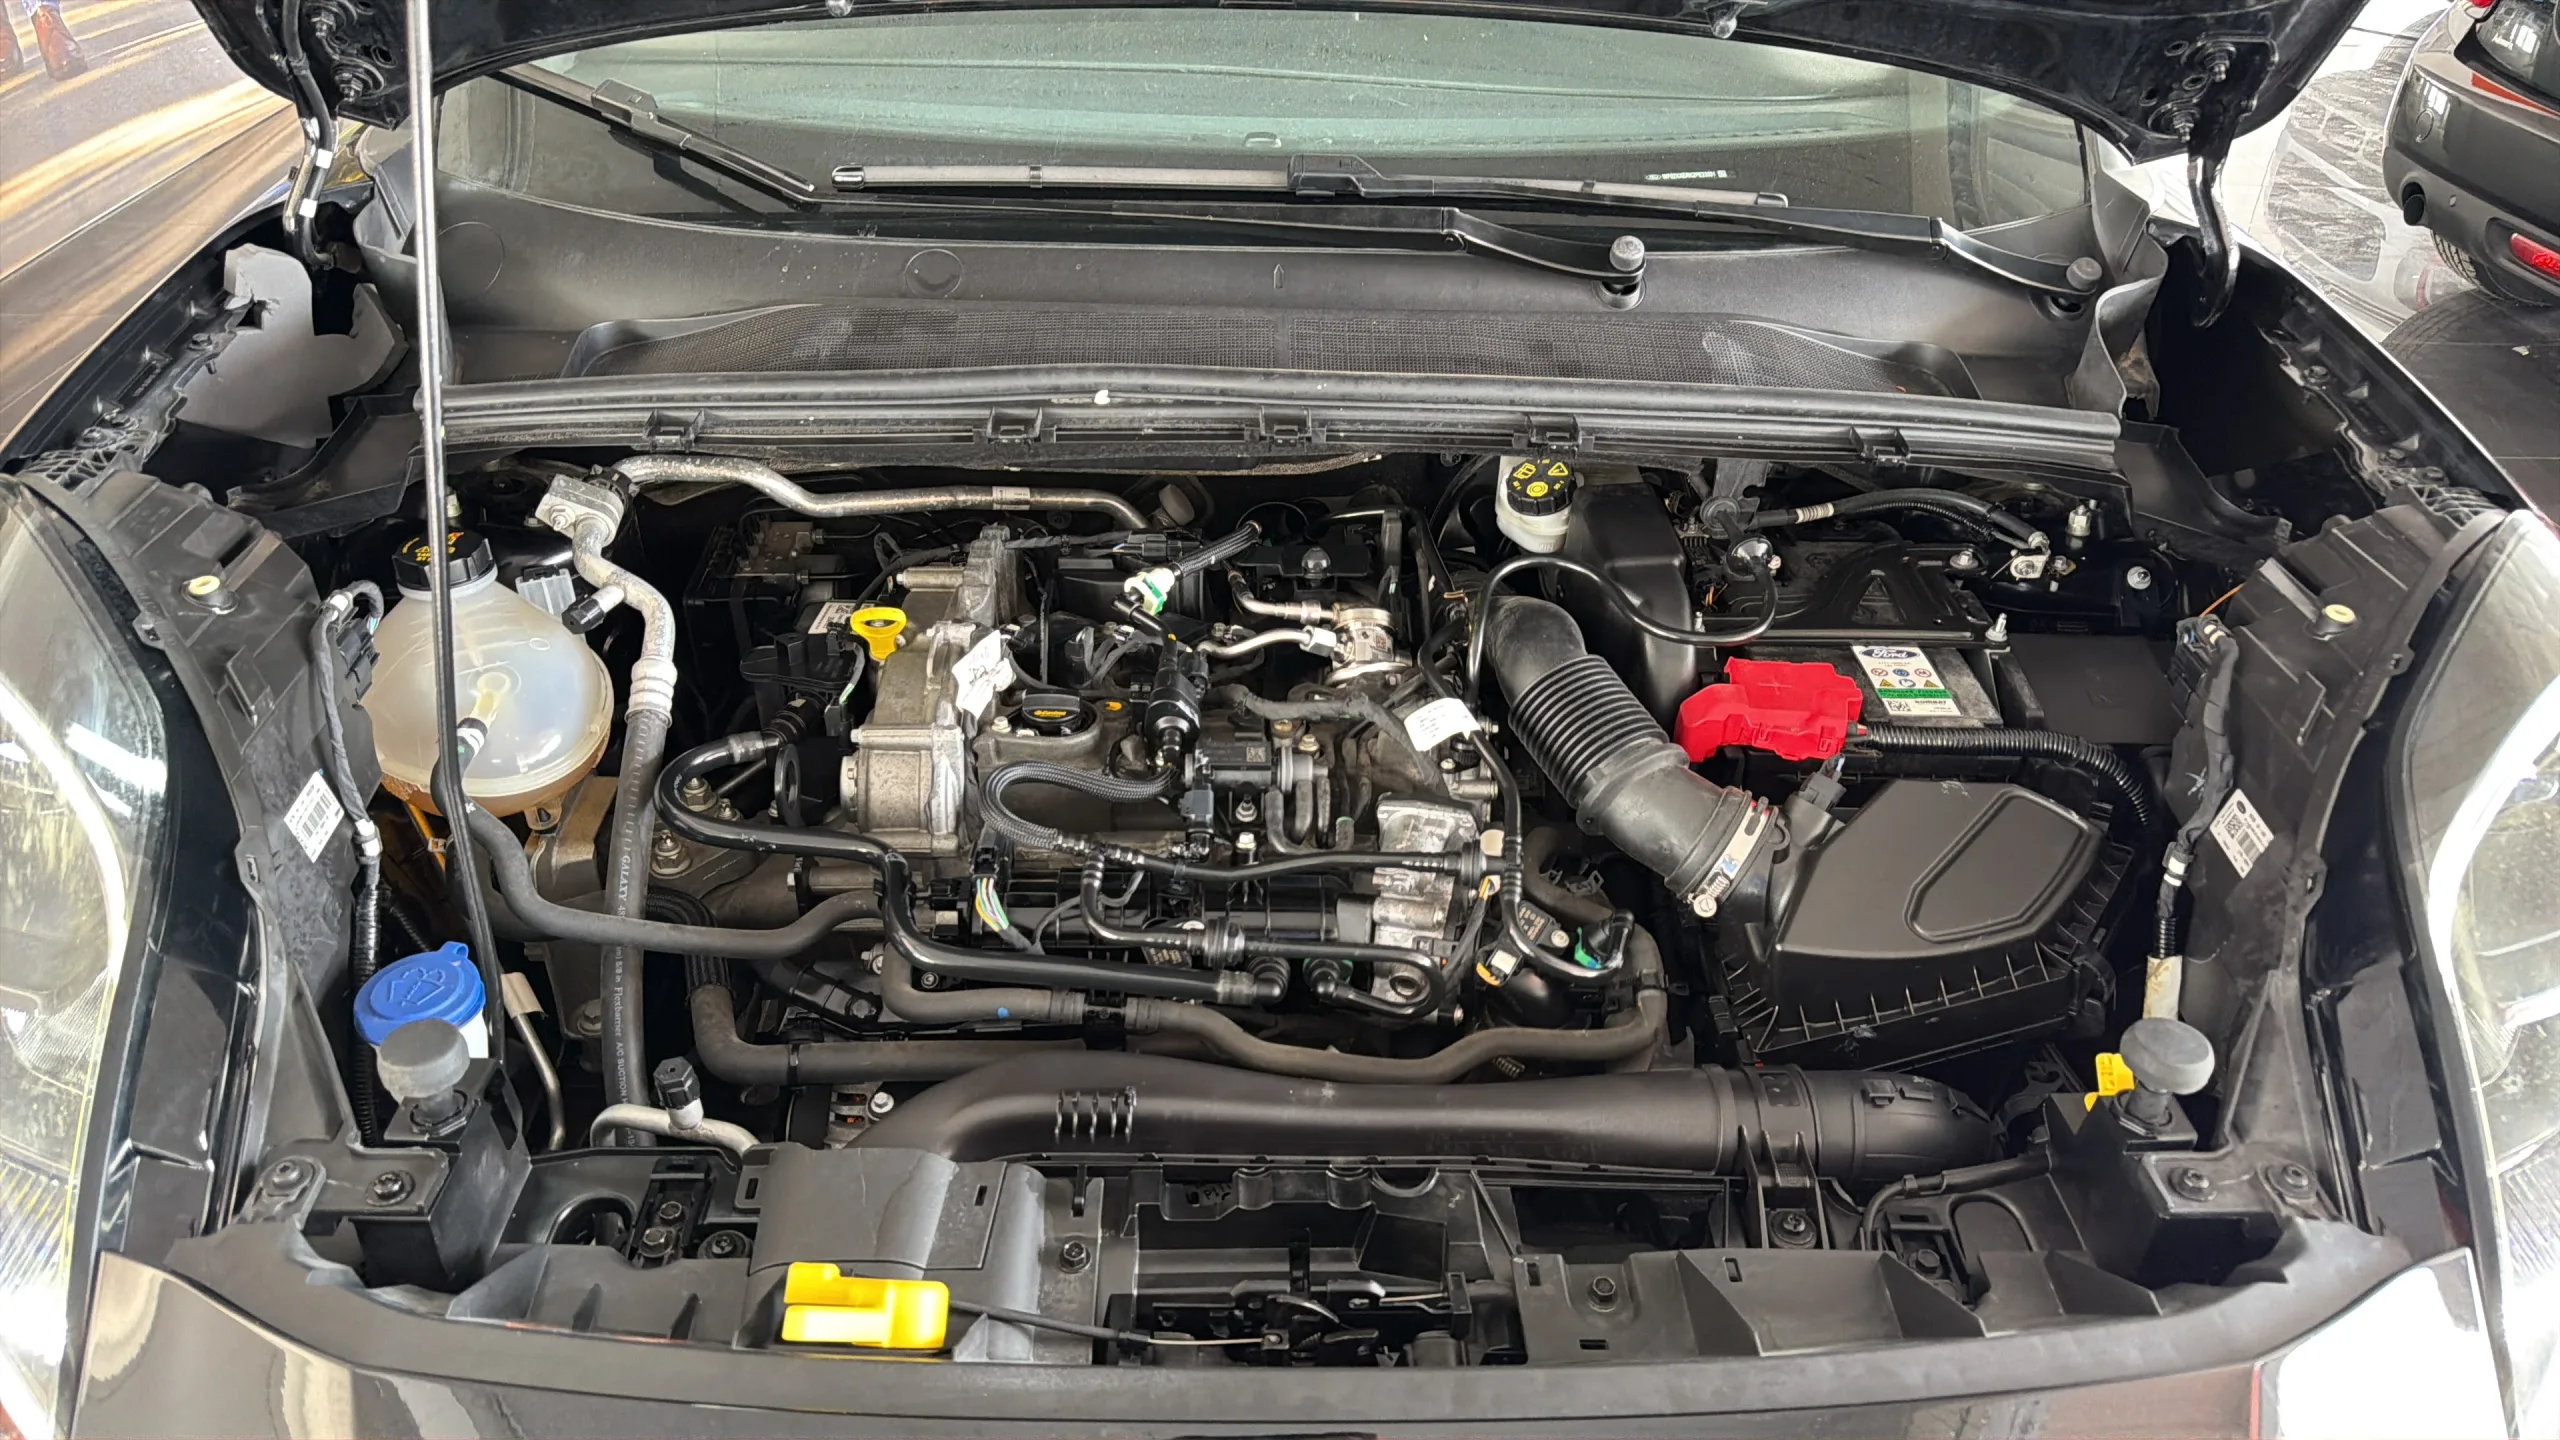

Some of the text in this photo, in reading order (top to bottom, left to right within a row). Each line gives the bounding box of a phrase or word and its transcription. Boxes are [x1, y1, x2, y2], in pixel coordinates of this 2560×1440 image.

[619, 855, 631, 901] GALAXY
[615, 960, 623, 973] 5/8
[614, 987, 624, 1037] Flexbarrier
[616, 1041, 625, 1056] A/C
[617, 1058, 628, 1097] SUCTION
